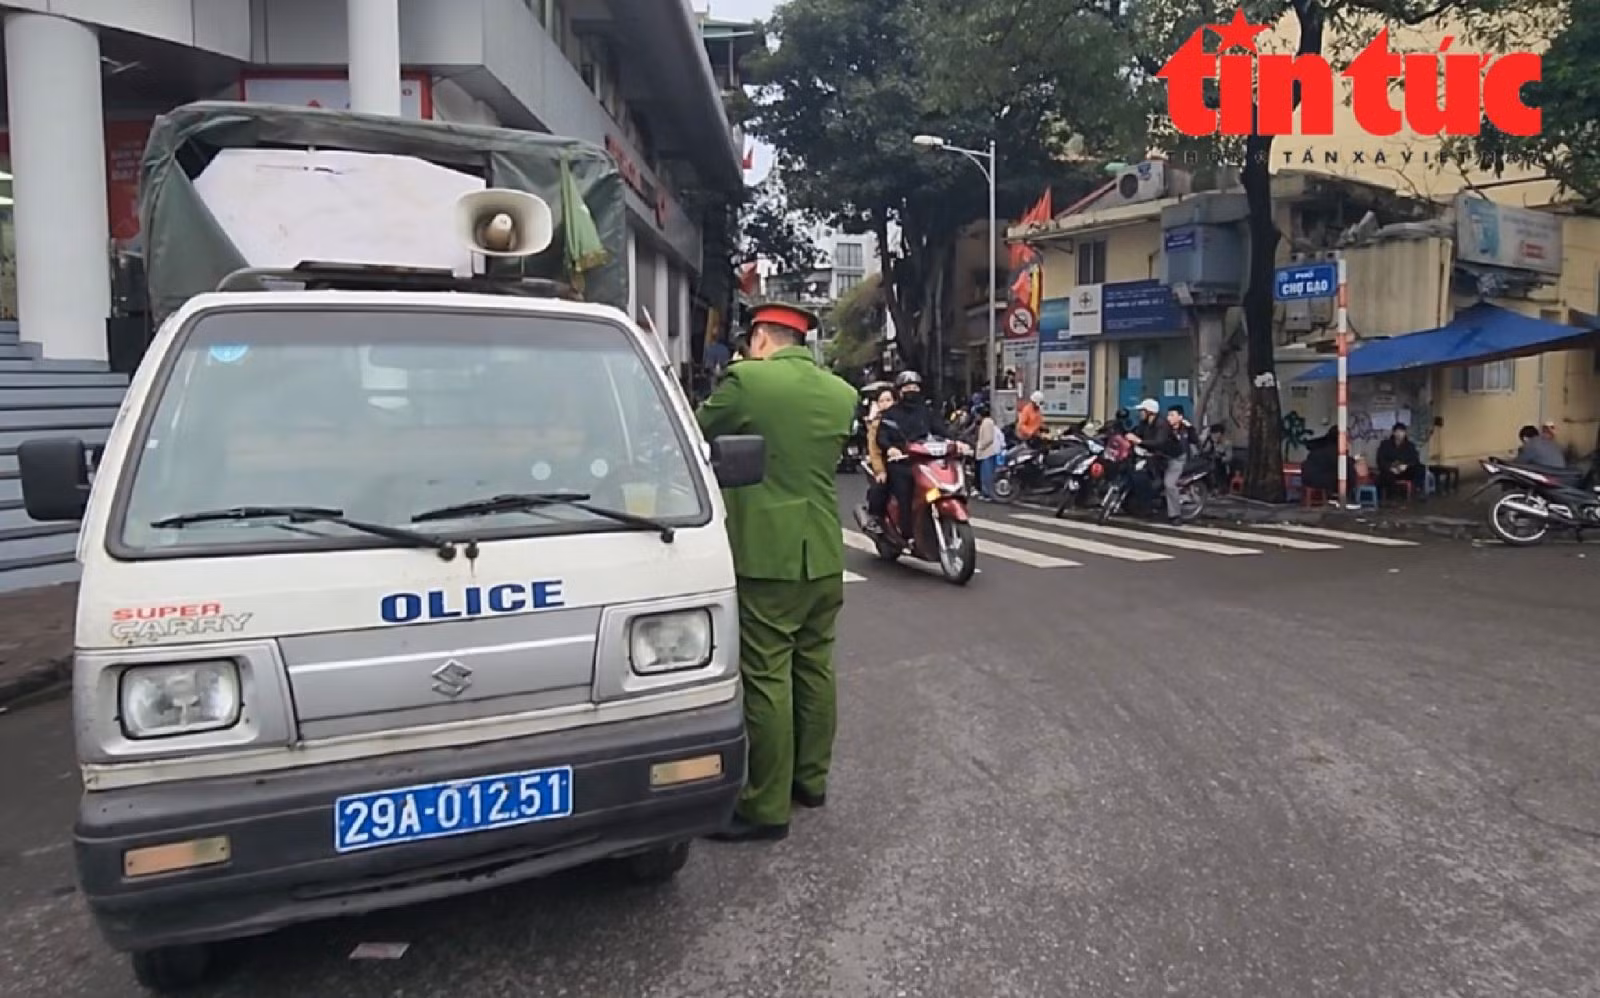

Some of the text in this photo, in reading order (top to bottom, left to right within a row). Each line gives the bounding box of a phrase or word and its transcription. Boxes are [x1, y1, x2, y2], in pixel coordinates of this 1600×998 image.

[1282, 279, 1328, 296] CHỢ GẠO
[113, 603, 221, 619] SUPER
[380, 579, 566, 624] OLICE
[111, 612, 253, 641] CARRY
[343, 772, 562, 845] 29A-012.51
